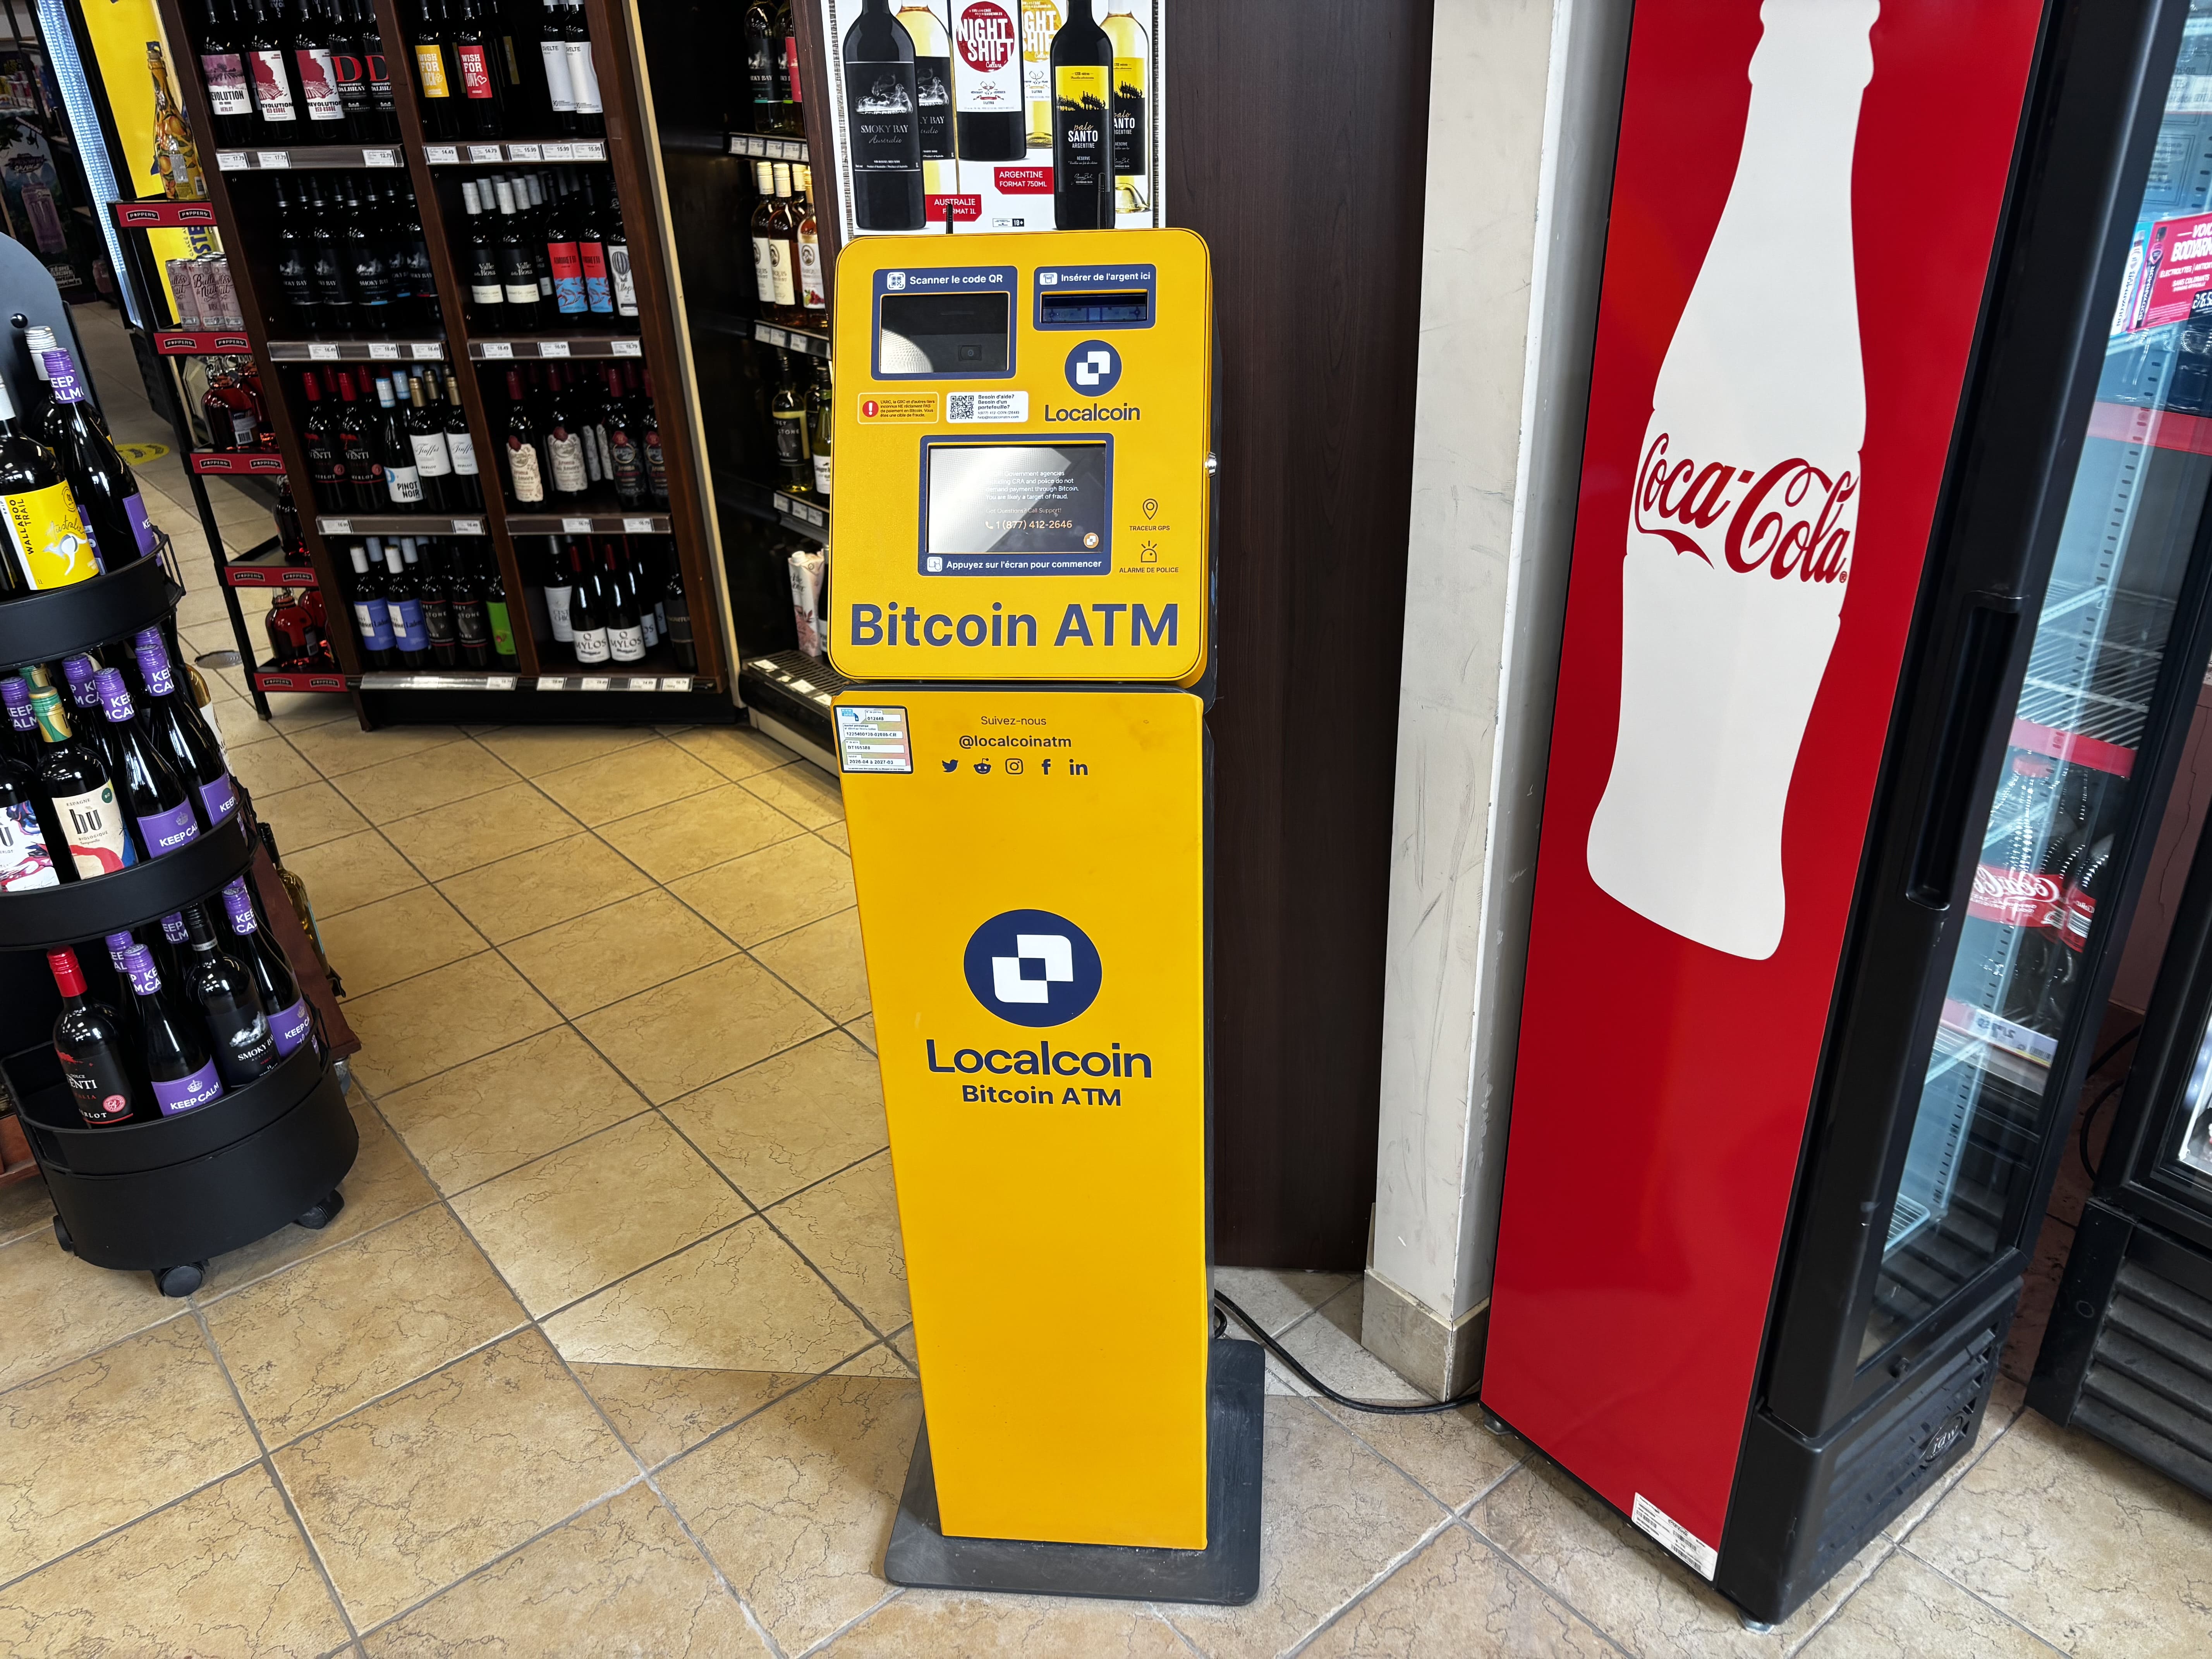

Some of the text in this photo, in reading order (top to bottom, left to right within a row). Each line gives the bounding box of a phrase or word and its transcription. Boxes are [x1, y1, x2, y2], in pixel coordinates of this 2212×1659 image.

[1024, 11, 1056, 33] GHT
[957, 18, 1008, 41] NIGHT
[967, 38, 1014, 62] SHIFT
[419, 53, 437, 62] WISH
[462, 53, 481, 62] WISH
[331, 56, 363, 82] D
[421, 62, 440, 72] FOR
[464, 62, 483, 72] FOR
[210, 91, 244, 100] EVOLUTION
[930, 116, 945, 124] BAY
[1114, 118, 1135, 129] ANTO
[861, 124, 908, 134] SMOKY BAY
[1073, 122, 1094, 131] palo
[1068, 131, 1098, 142] SANTO
[909, 273, 1003, 285] Scanner le code QR
[1061, 272, 1151, 283] Insérer de l'argent ici
[55, 387, 82, 402] ALM
[1044, 403, 1140, 422] Localcoin
[397, 481, 418, 491] PINOT
[402, 489, 420, 498] NOIR
[17, 499, 31, 526] TRAIL
[1635, 432, 1859, 584] Coca-Cola
[9, 500, 34, 555] WALLAROO
[1002, 520, 1027, 530] (877)
[1029, 520, 1073, 529] 412-2646
[946, 560, 983, 571] Appuyez
[1000, 560, 1029, 568] l'écran
[1032, 562, 1049, 570] pour
[851, 601, 1178, 647] Bitcoin ATM
[576, 638, 607, 650] MYLOS
[610, 637, 642, 648] MYLOS
[14, 716, 38, 728] ALM
[981, 716, 1047, 726] Suivez-nous
[958, 735, 1072, 750] @localcoinatm
[79, 831, 108, 841] BIOLOGIQUE
[159, 831, 185, 847] KEEP
[162, 921, 183, 933] EEP
[166, 931, 189, 942] ALM
[285, 1023, 304, 1039] KEEP
[238, 1043, 267, 1061] SMOKY
[926, 1039, 1152, 1078] Localcoin
[69, 1074, 98, 1089] ENTI
[170, 1081, 220, 1110] KEEP CALM
[962, 1085, 1121, 1106] Bitcoin ATM
[79, 1109, 107, 1118] RLOT
